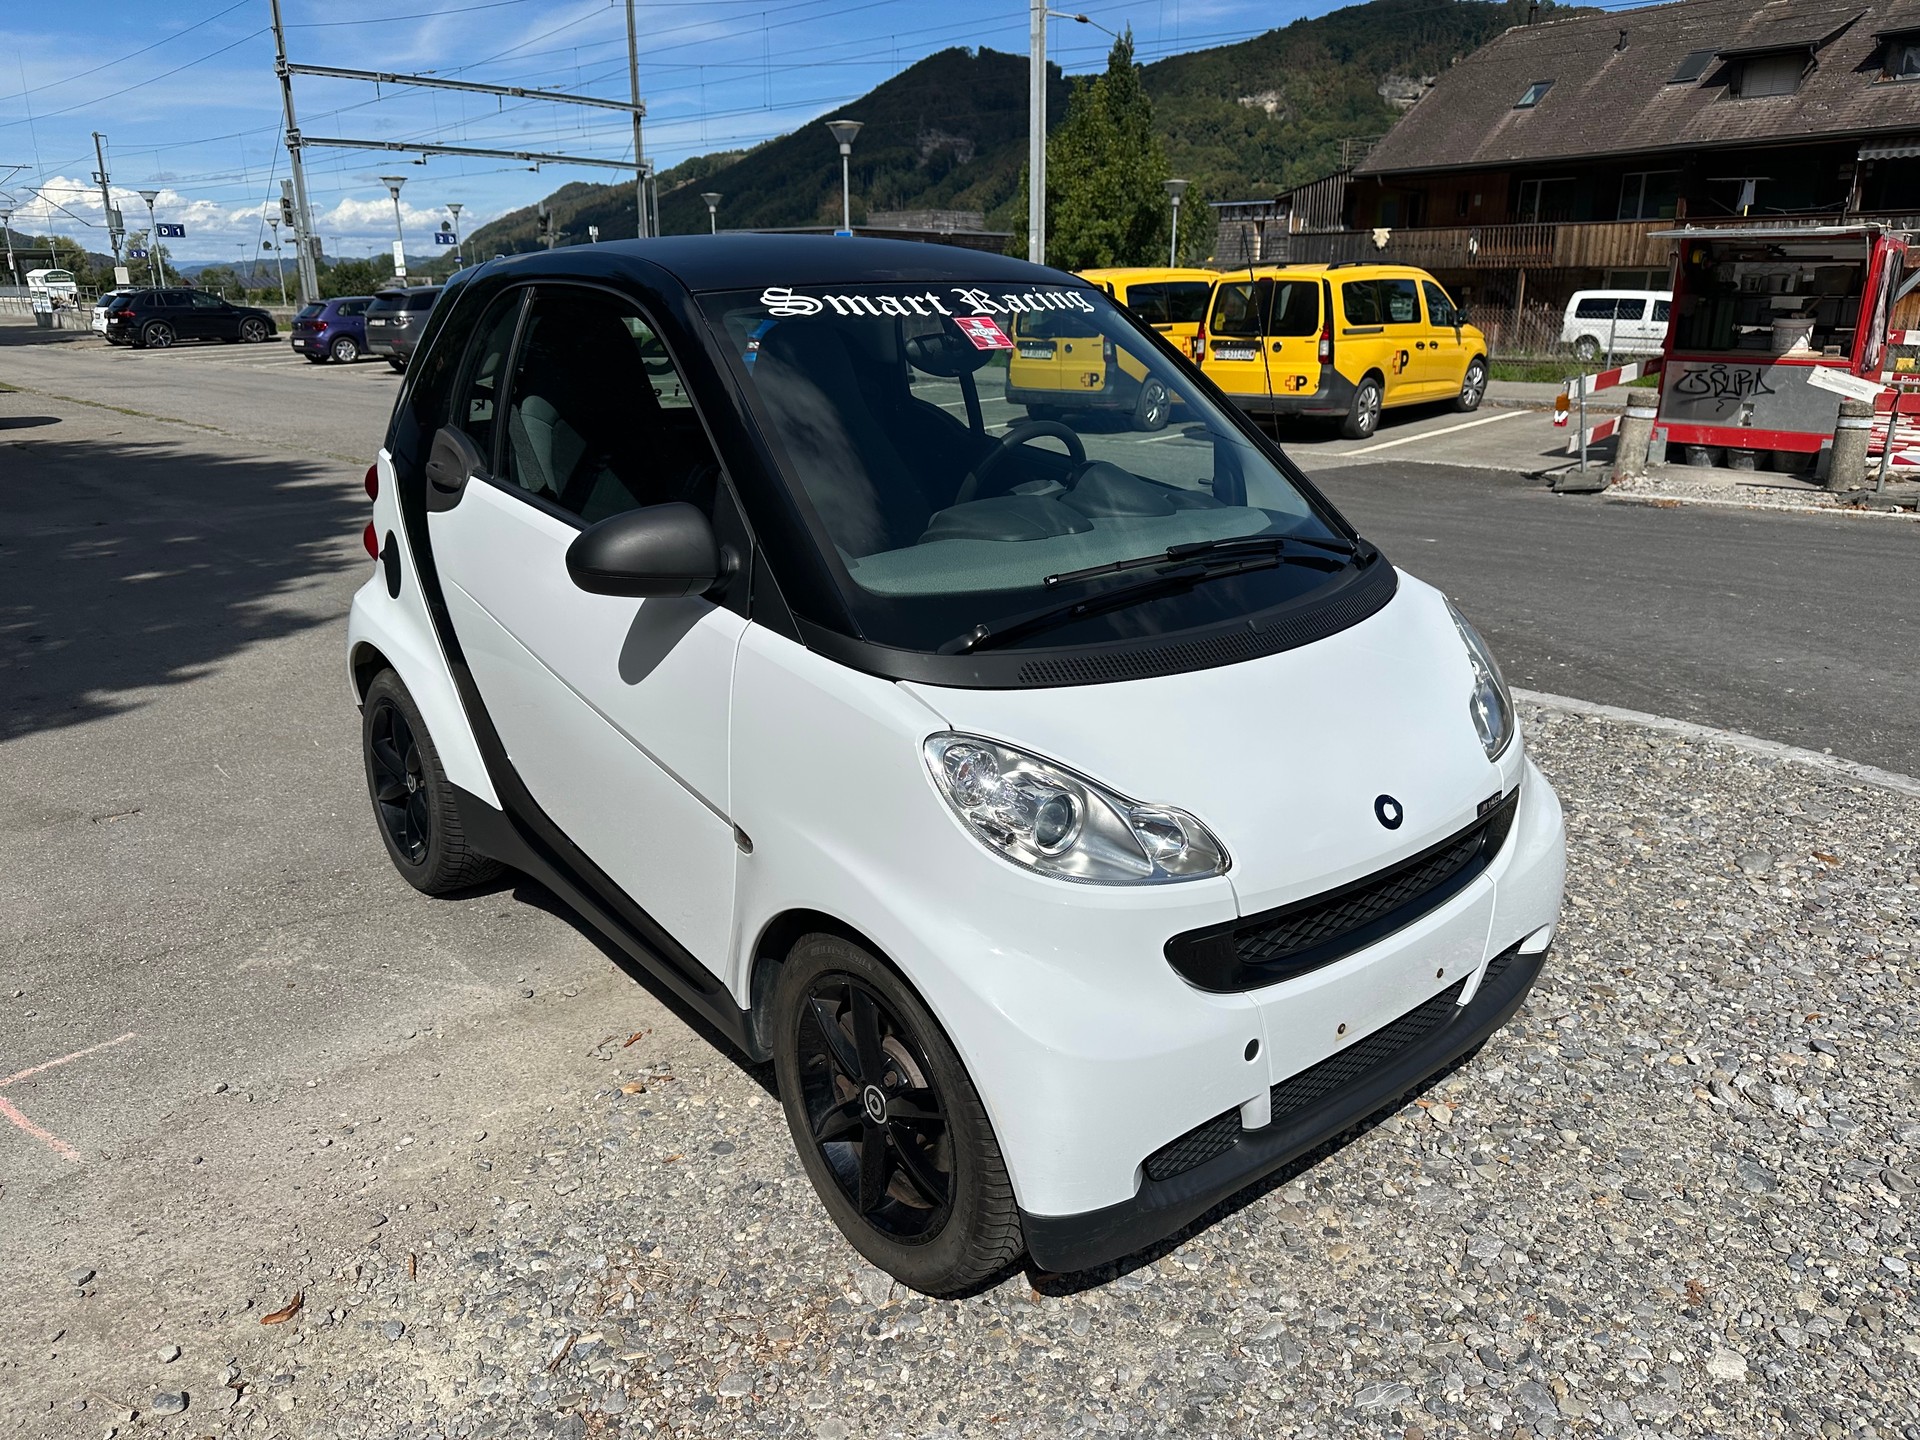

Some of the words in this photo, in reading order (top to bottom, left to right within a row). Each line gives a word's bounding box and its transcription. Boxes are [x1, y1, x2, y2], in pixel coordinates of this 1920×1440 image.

[161, 227, 169, 236] D
[760, 287, 952, 316] Smart
[951, 287, 1095, 316] Racing
[1399, 350, 1409, 374] P
[1090, 373, 1100, 387] P
[1295, 376, 1307, 391] P
